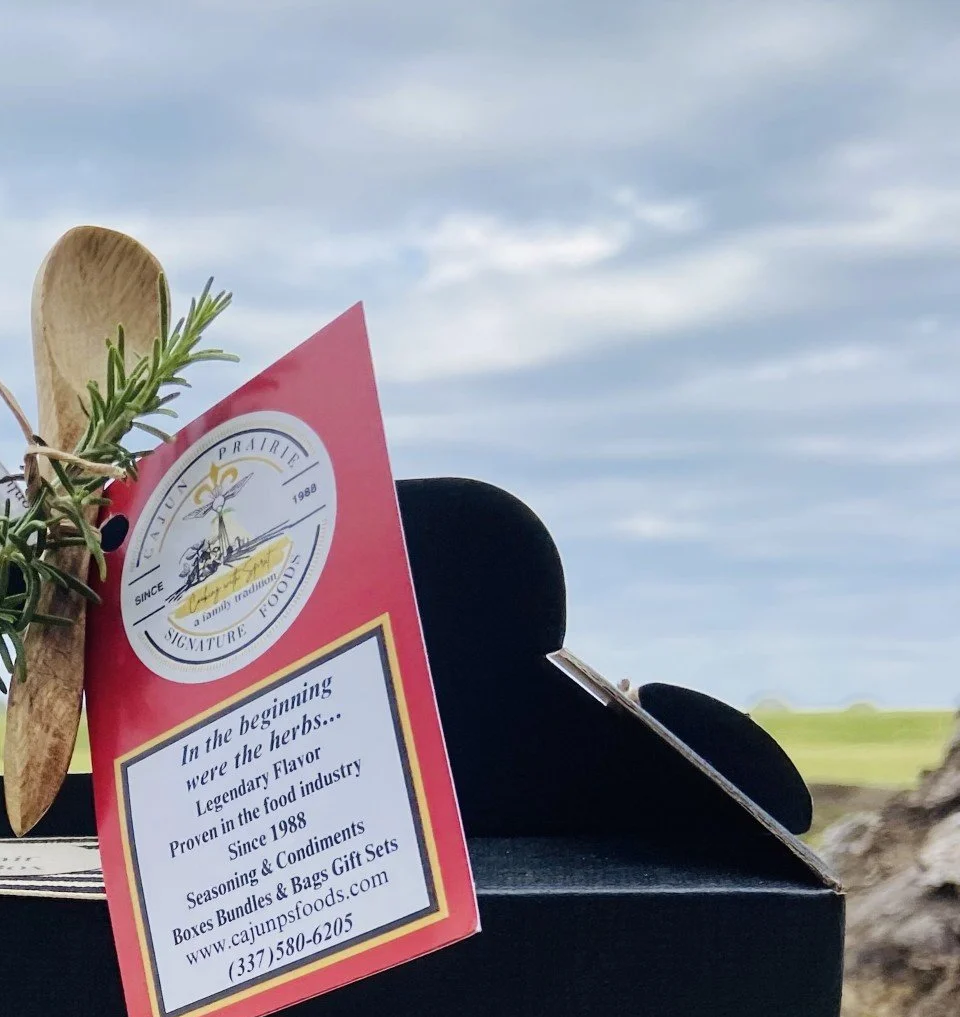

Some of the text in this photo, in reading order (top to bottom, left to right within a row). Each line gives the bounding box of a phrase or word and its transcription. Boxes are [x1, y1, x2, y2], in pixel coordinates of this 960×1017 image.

[143, 436, 300, 560] CAJUN PRAIRIE
[291, 483, 318, 505] 1988
[134, 581, 164, 606] SINCE
[164, 553, 301, 652] SIGNATURE FOODS
[201, 600, 234, 624] family
[234, 571, 278, 604] tradition
[181, 675, 333, 766] In the beginning
[186, 713, 342, 792] were the herbs...
[168, 756, 363, 858] Proven in the food industry
[195, 746, 322, 817] Legendary Flavor
[185, 818, 366, 912] Seasoning & Condiments
[228, 811, 307, 862] Since 1988
[172, 837, 399, 946] Boxes Bundles & Bags Gift Sets
[185, 870, 389, 966] www.cajunpsfoods.com
[228, 913, 354, 983] (337)580-6205
